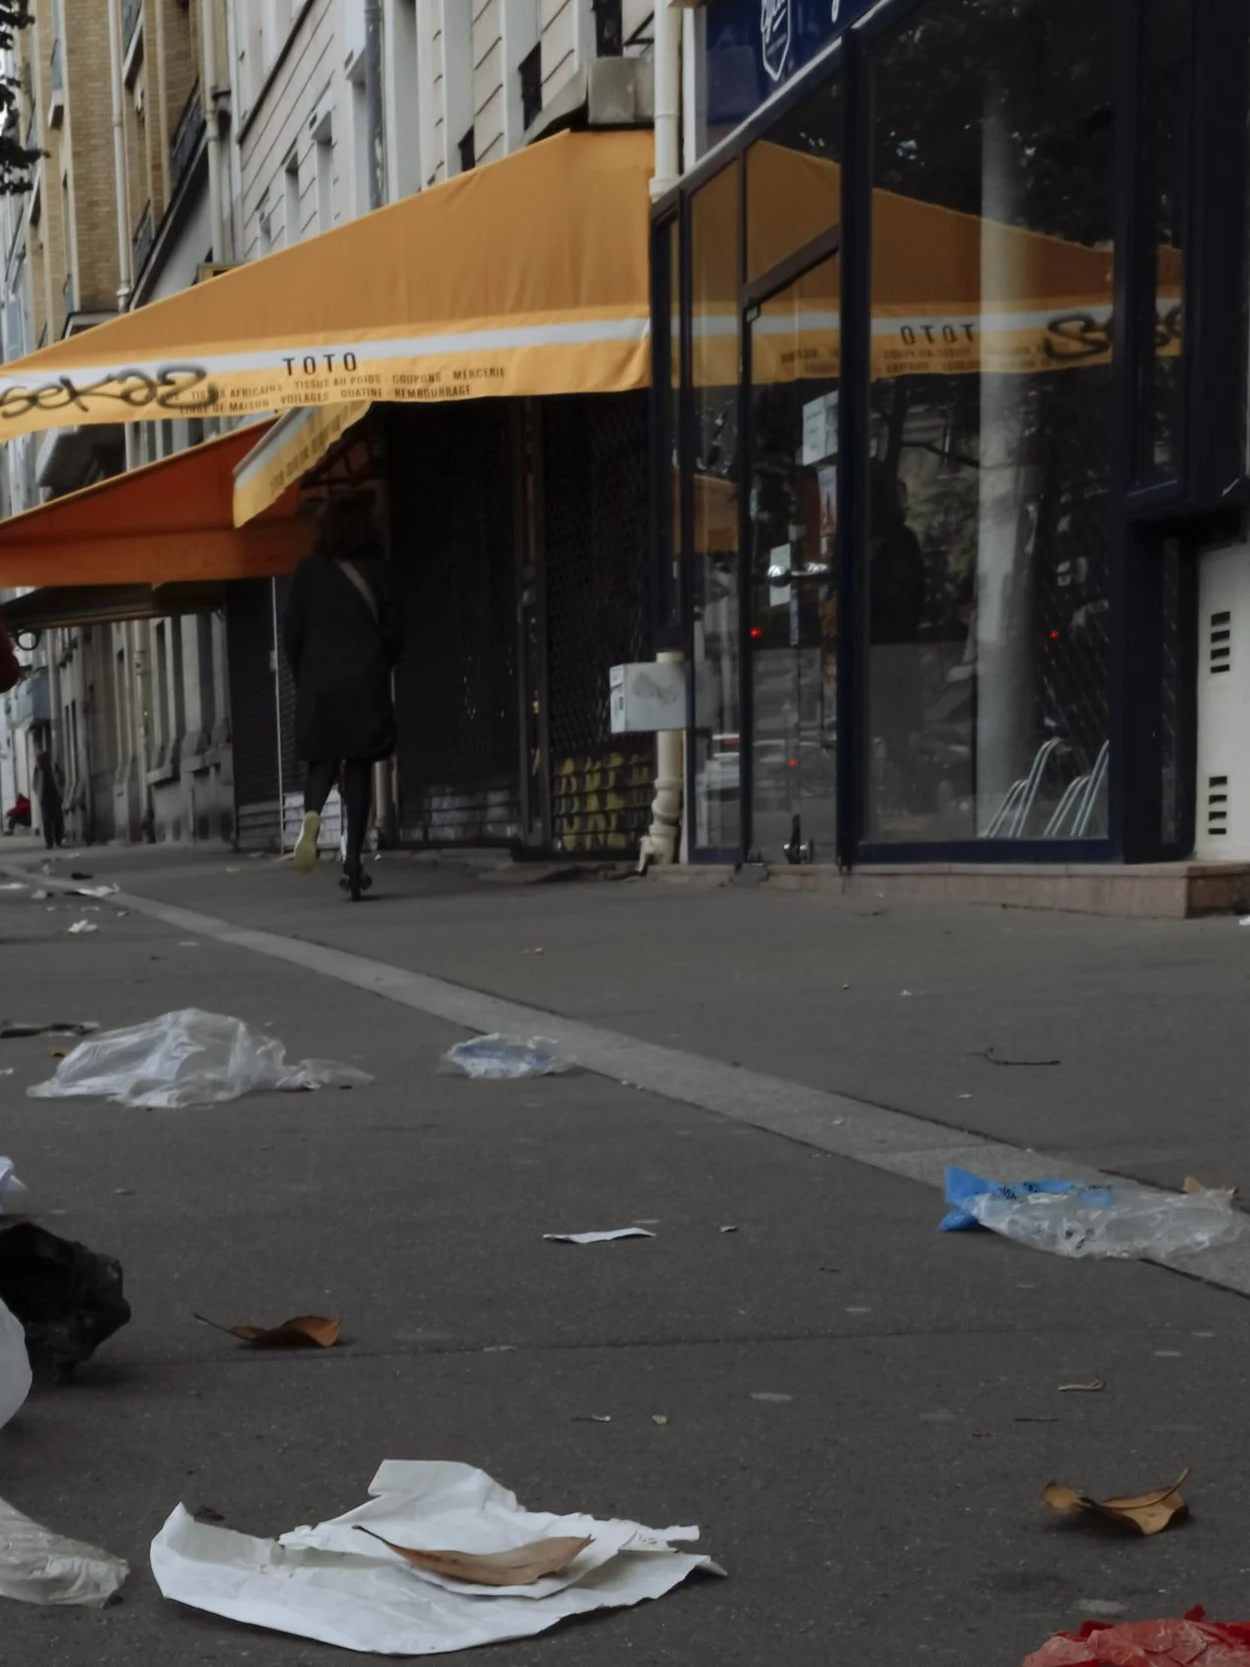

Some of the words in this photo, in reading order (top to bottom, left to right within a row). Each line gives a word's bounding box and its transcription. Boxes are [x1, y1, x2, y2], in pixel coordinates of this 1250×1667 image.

[282, 352, 357, 376] TOTO
[192, 389, 226, 401] TISS
[294, 377, 330, 390] TISSUS
[333, 377, 347, 387] AU
[351, 373, 381, 386] POIDS
[392, 371, 441, 385] COUPONS
[453, 366, 505, 380] MERCERIE
[230, 398, 269, 412] MAISON
[394, 384, 471, 398] REMBOURRAGE
